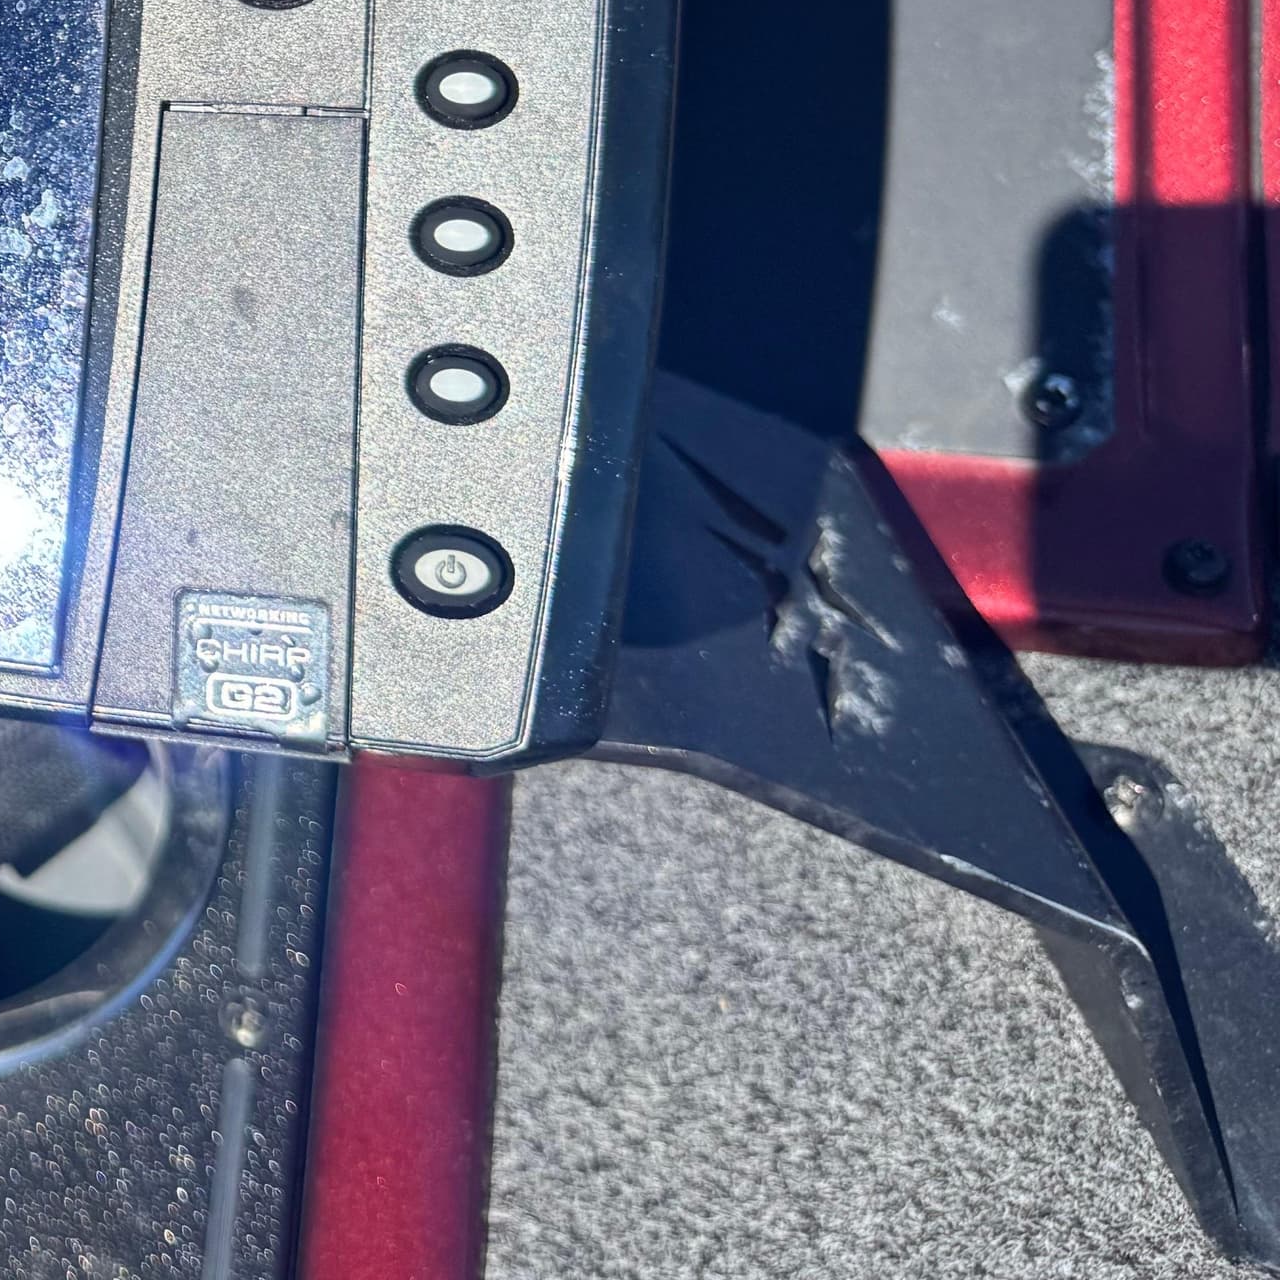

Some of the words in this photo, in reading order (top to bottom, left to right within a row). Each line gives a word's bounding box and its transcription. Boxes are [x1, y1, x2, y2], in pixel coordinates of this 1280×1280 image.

[197, 603, 311, 625] NETWORKING
[196, 638, 311, 667] CHIRP
[220, 683, 286, 712] G2
